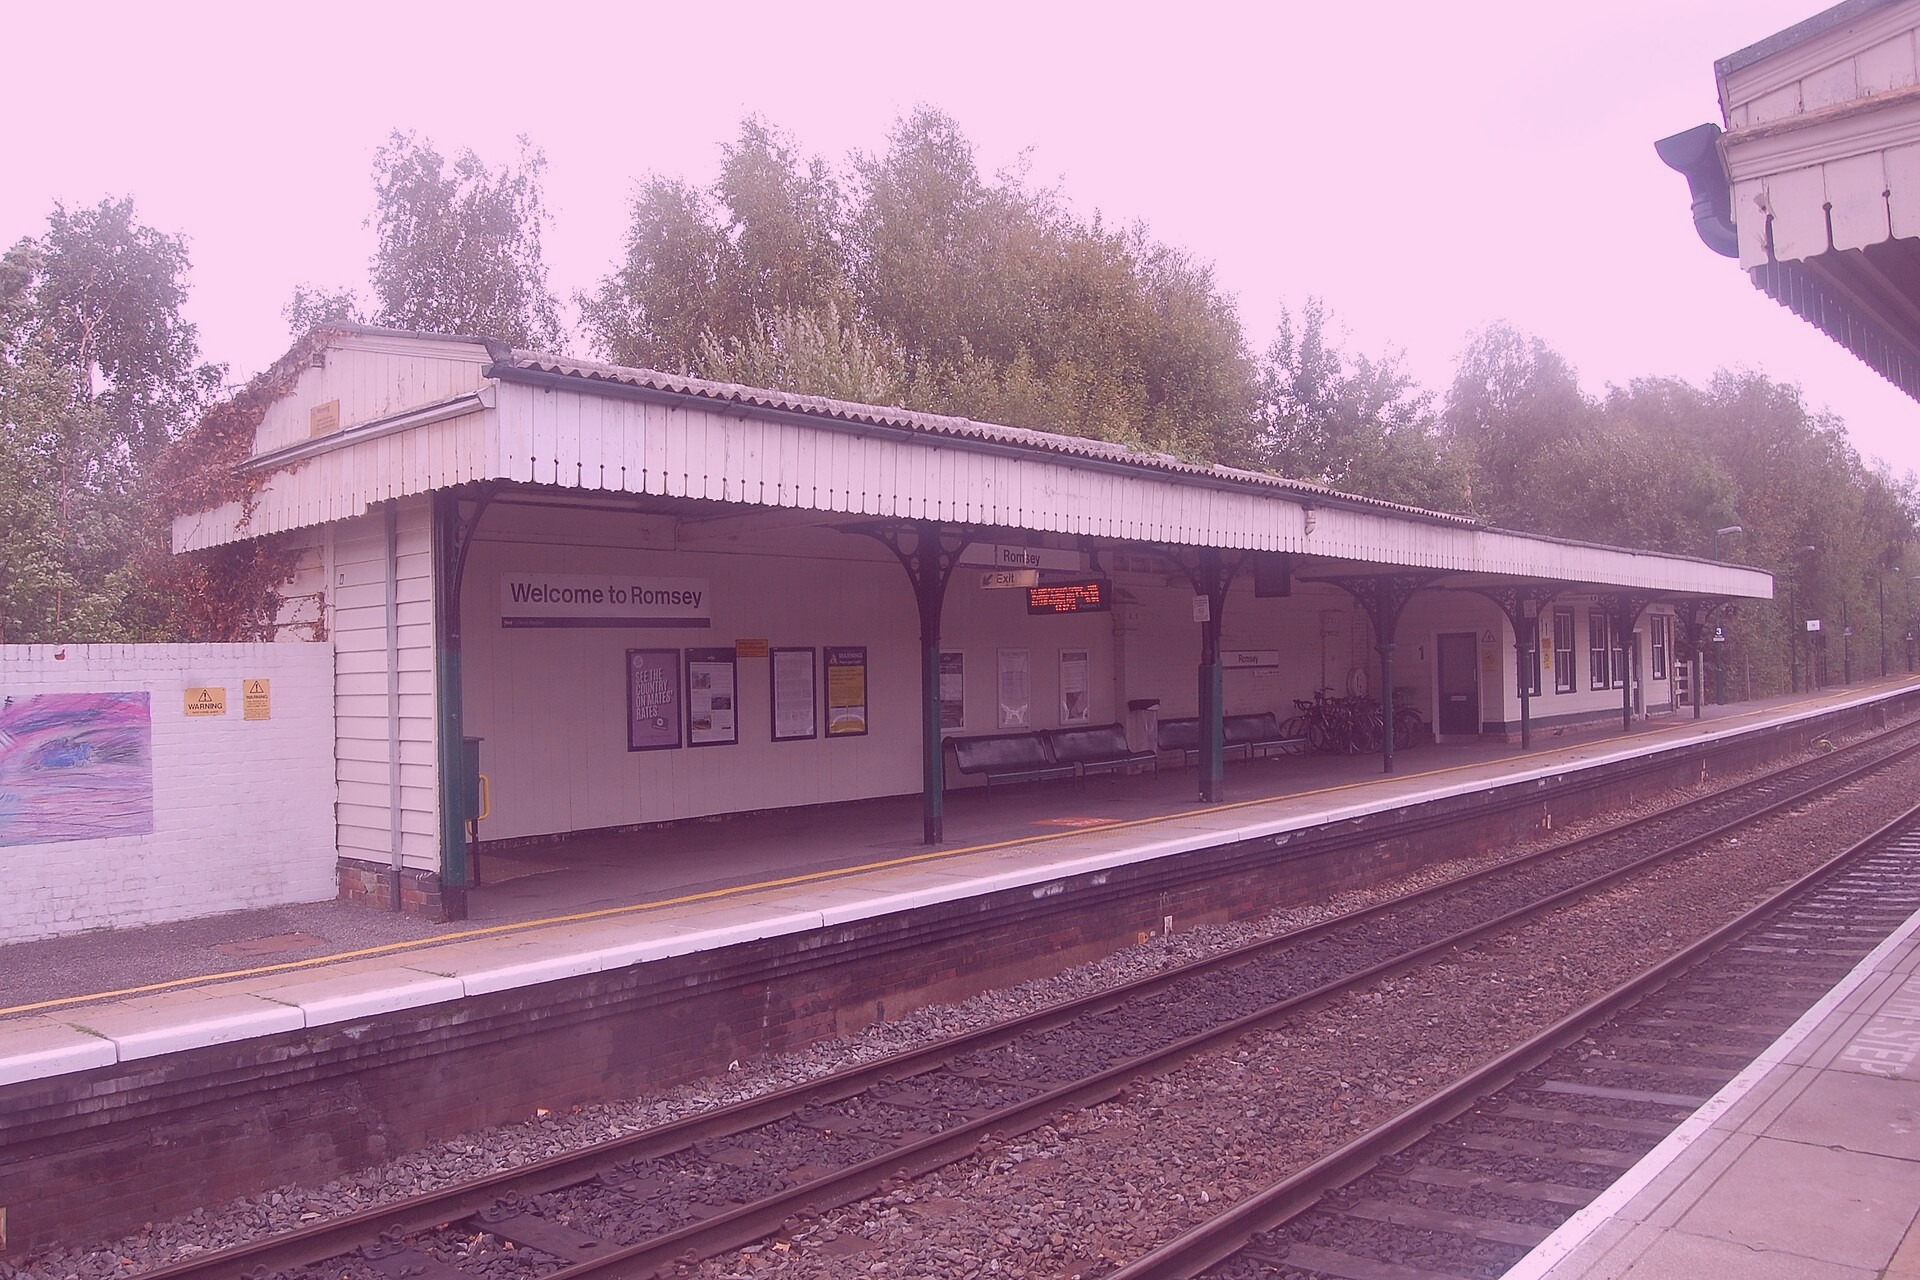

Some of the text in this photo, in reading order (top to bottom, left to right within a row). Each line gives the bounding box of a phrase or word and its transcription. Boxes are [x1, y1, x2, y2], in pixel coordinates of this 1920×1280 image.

[1003, 549, 1040, 566] Romsey
[996, 573, 1015, 584] Exit
[510, 582, 703, 608] Welcome to Romsey
[1716, 627, 1722, 635] 3
[1238, 654, 1258, 664] Romsey
[1418, 646, 1424, 660] 1
[635, 668, 663, 684] SEE THE
[636, 679, 668, 696] COUNTRY
[188, 702, 223, 710] WARNING
[636, 694, 646, 708] ON
